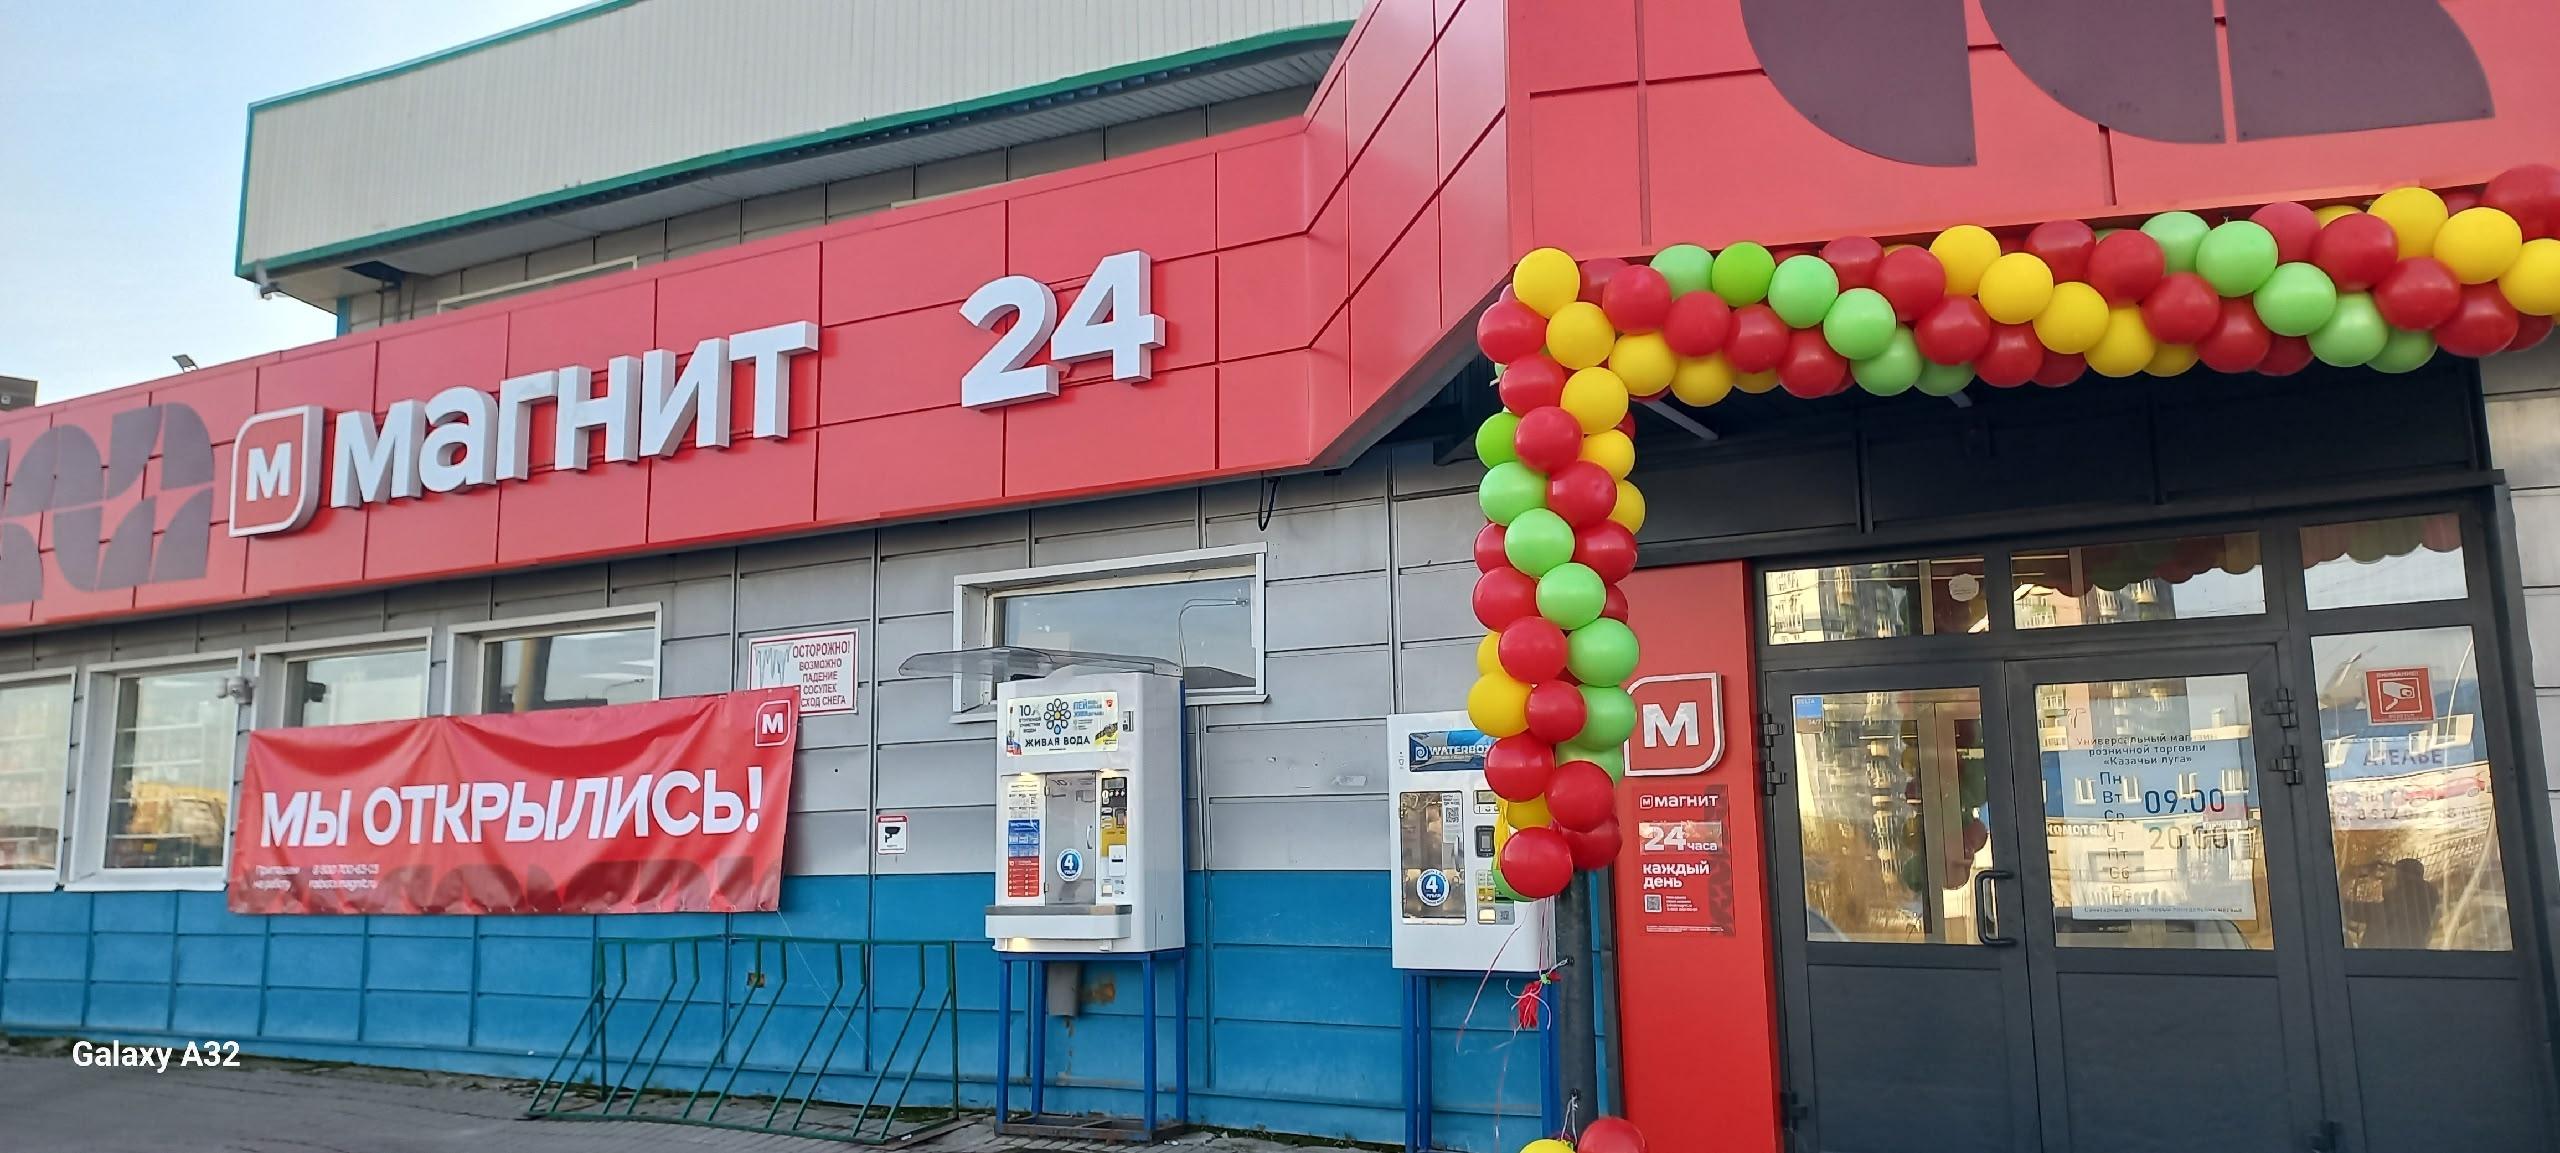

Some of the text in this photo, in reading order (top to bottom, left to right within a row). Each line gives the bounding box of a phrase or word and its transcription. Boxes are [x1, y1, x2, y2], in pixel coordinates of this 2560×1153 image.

[959, 250, 1166, 408] 24
[793, 641, 850, 658] ОСТОРОЖНО!
[799, 658, 842, 671] ВОЗМОЖНО
[803, 671, 838, 683] ПАДЕНИЕ
[800, 696, 846, 708] СХОД СНЕГА
[1019, 705, 1031, 717] 10
[1025, 736, 1090, 747] ЖИВАЯ ВОДА
[2077, 733, 2217, 746] Универсальный магзин
[2089, 744, 2206, 757] розничной торговли
[2103, 756, 2192, 766] «Казачьи луга»
[2100, 771, 2122, 785] Пн
[2103, 790, 2122, 803] Вт
[260, 767, 762, 848] МЫ ОТКРЫЛИСЬ!
[2104, 809, 2125, 825] Ср
[1644, 825, 1718, 851] 24 часа
[2106, 827, 2125, 842] Чт
[1064, 855, 1074, 869] 4
[1642, 860, 1710, 876] каждый
[2109, 866, 2130, 880] Сб
[1426, 875, 1438, 893] 4
[1643, 877, 1683, 889] день
